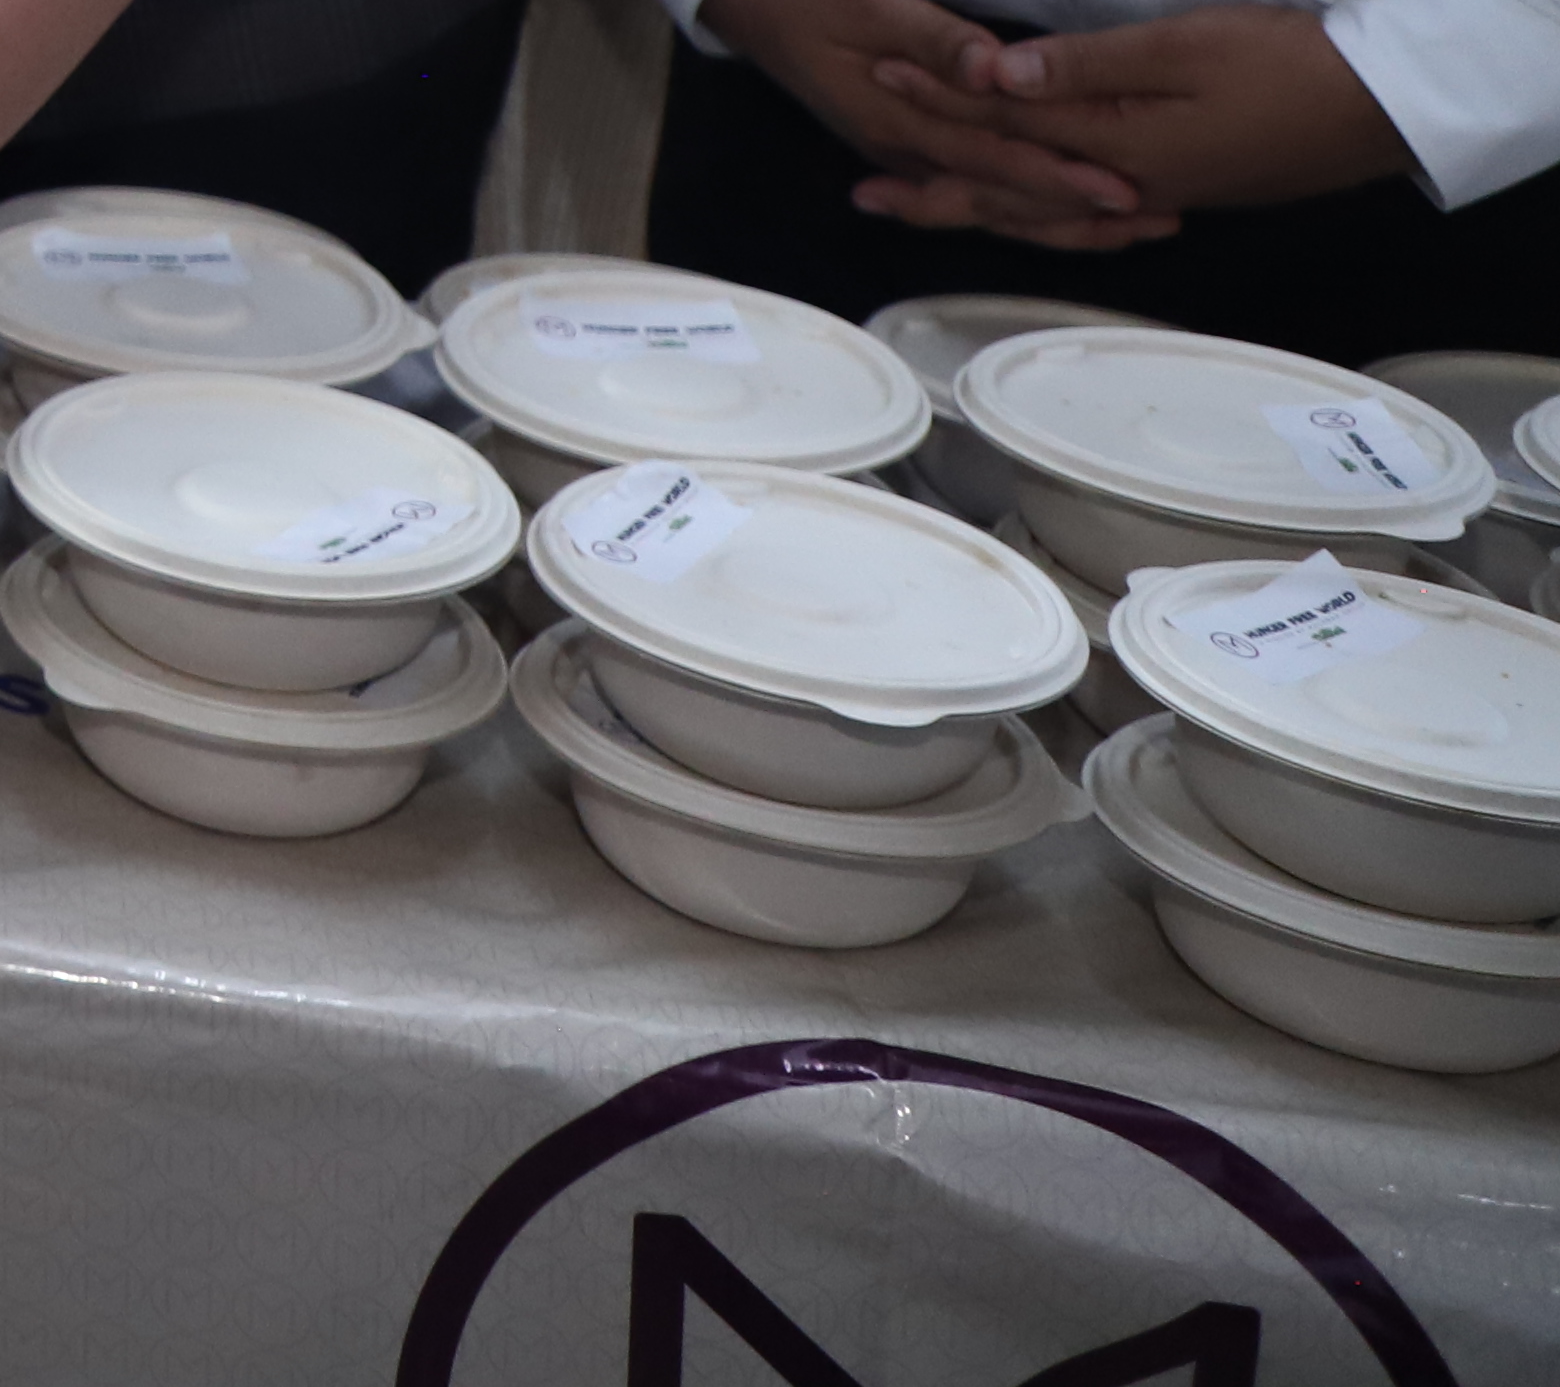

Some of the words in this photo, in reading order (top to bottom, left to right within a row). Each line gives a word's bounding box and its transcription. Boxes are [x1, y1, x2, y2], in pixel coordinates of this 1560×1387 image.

[1243, 621, 1289, 640] HUNGER
[1287, 610, 1317, 628] FREE
[1318, 590, 1356, 615] WORLD
